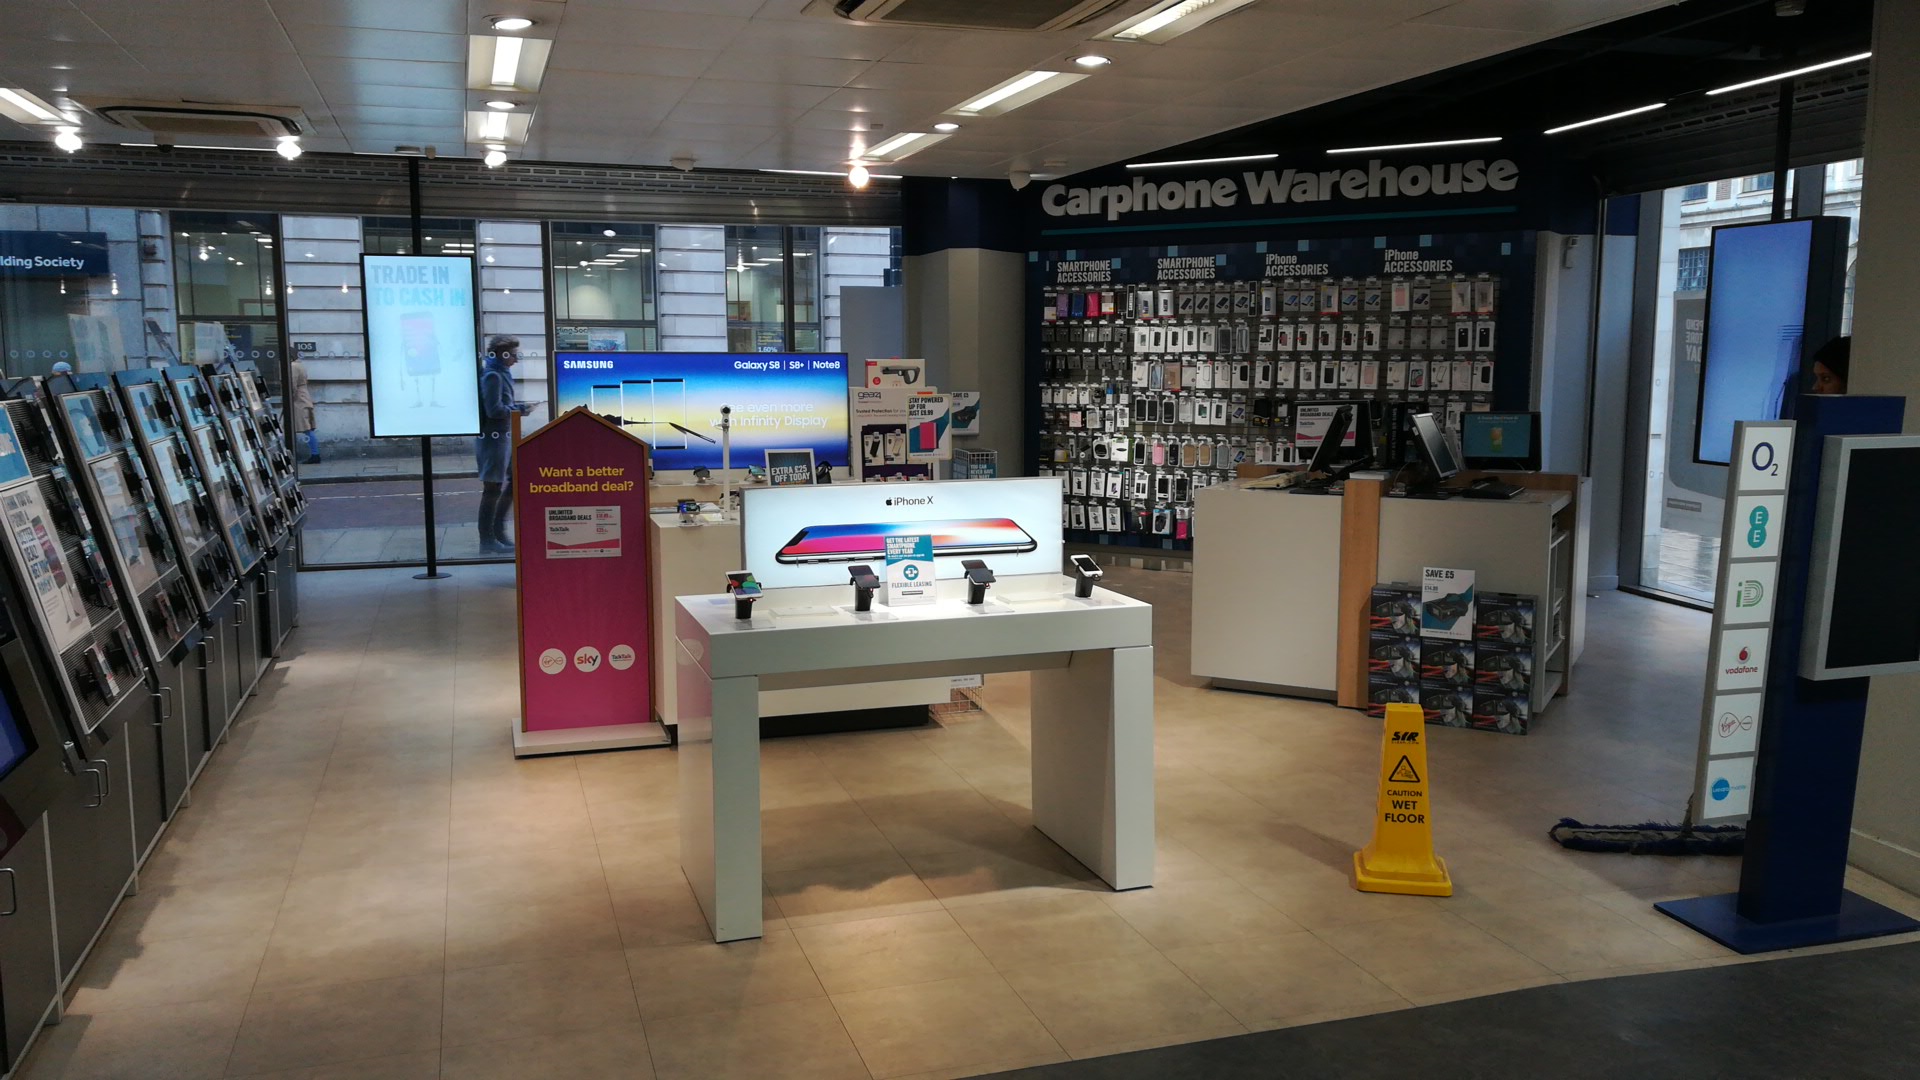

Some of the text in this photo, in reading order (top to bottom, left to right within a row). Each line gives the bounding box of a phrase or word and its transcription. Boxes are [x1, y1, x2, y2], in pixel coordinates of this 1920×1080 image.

[1041, 158, 1519, 221] Carphone Warehouse
[1265, 253, 1297, 265] iPhone
[1384, 248, 1419, 261] iPhone
[0, 256, 84, 270] lding Society
[1057, 259, 1111, 273] SMARTPHONE
[1157, 256, 1215, 270] SMARTPHONE
[1384, 259, 1453, 273] ACCESSORIES
[371, 264, 450, 285] TRADE IN
[1157, 268, 1215, 281] ACCESSORIES
[1265, 263, 1329, 277] ACCESSORIES
[1057, 270, 1111, 283] ACCESSORIES
[372, 287, 466, 307] TO CASH IN
[297, 343, 313, 351] 105
[563, 360, 614, 369] SAMSUNG
[733, 360, 841, 371] Galaxy S8 S8+ Note8
[747, 404, 777, 413] even
[780, 403, 814, 413] more
[709, 415, 829, 430] wh Infinity Display
[1751, 441, 1779, 477] O2
[538, 466, 625, 478] Want a better
[771, 464, 808, 476] EXTRA £25
[774, 471, 811, 483] OFF TODAY
[529, 480, 634, 493] broadband deal?
[893, 495, 934, 506] iPhone X
[1753, 511, 1764, 544] EE
[1425, 569, 1455, 579] SAVE £5
[577, 654, 599, 666] sky
[1725, 664, 1758, 675] vodafone
[1391, 731, 1419, 741] SIR
[1387, 789, 1423, 797] CAUTION
[1391, 800, 1418, 810] WET
[1384, 812, 1425, 824] FLOOR
